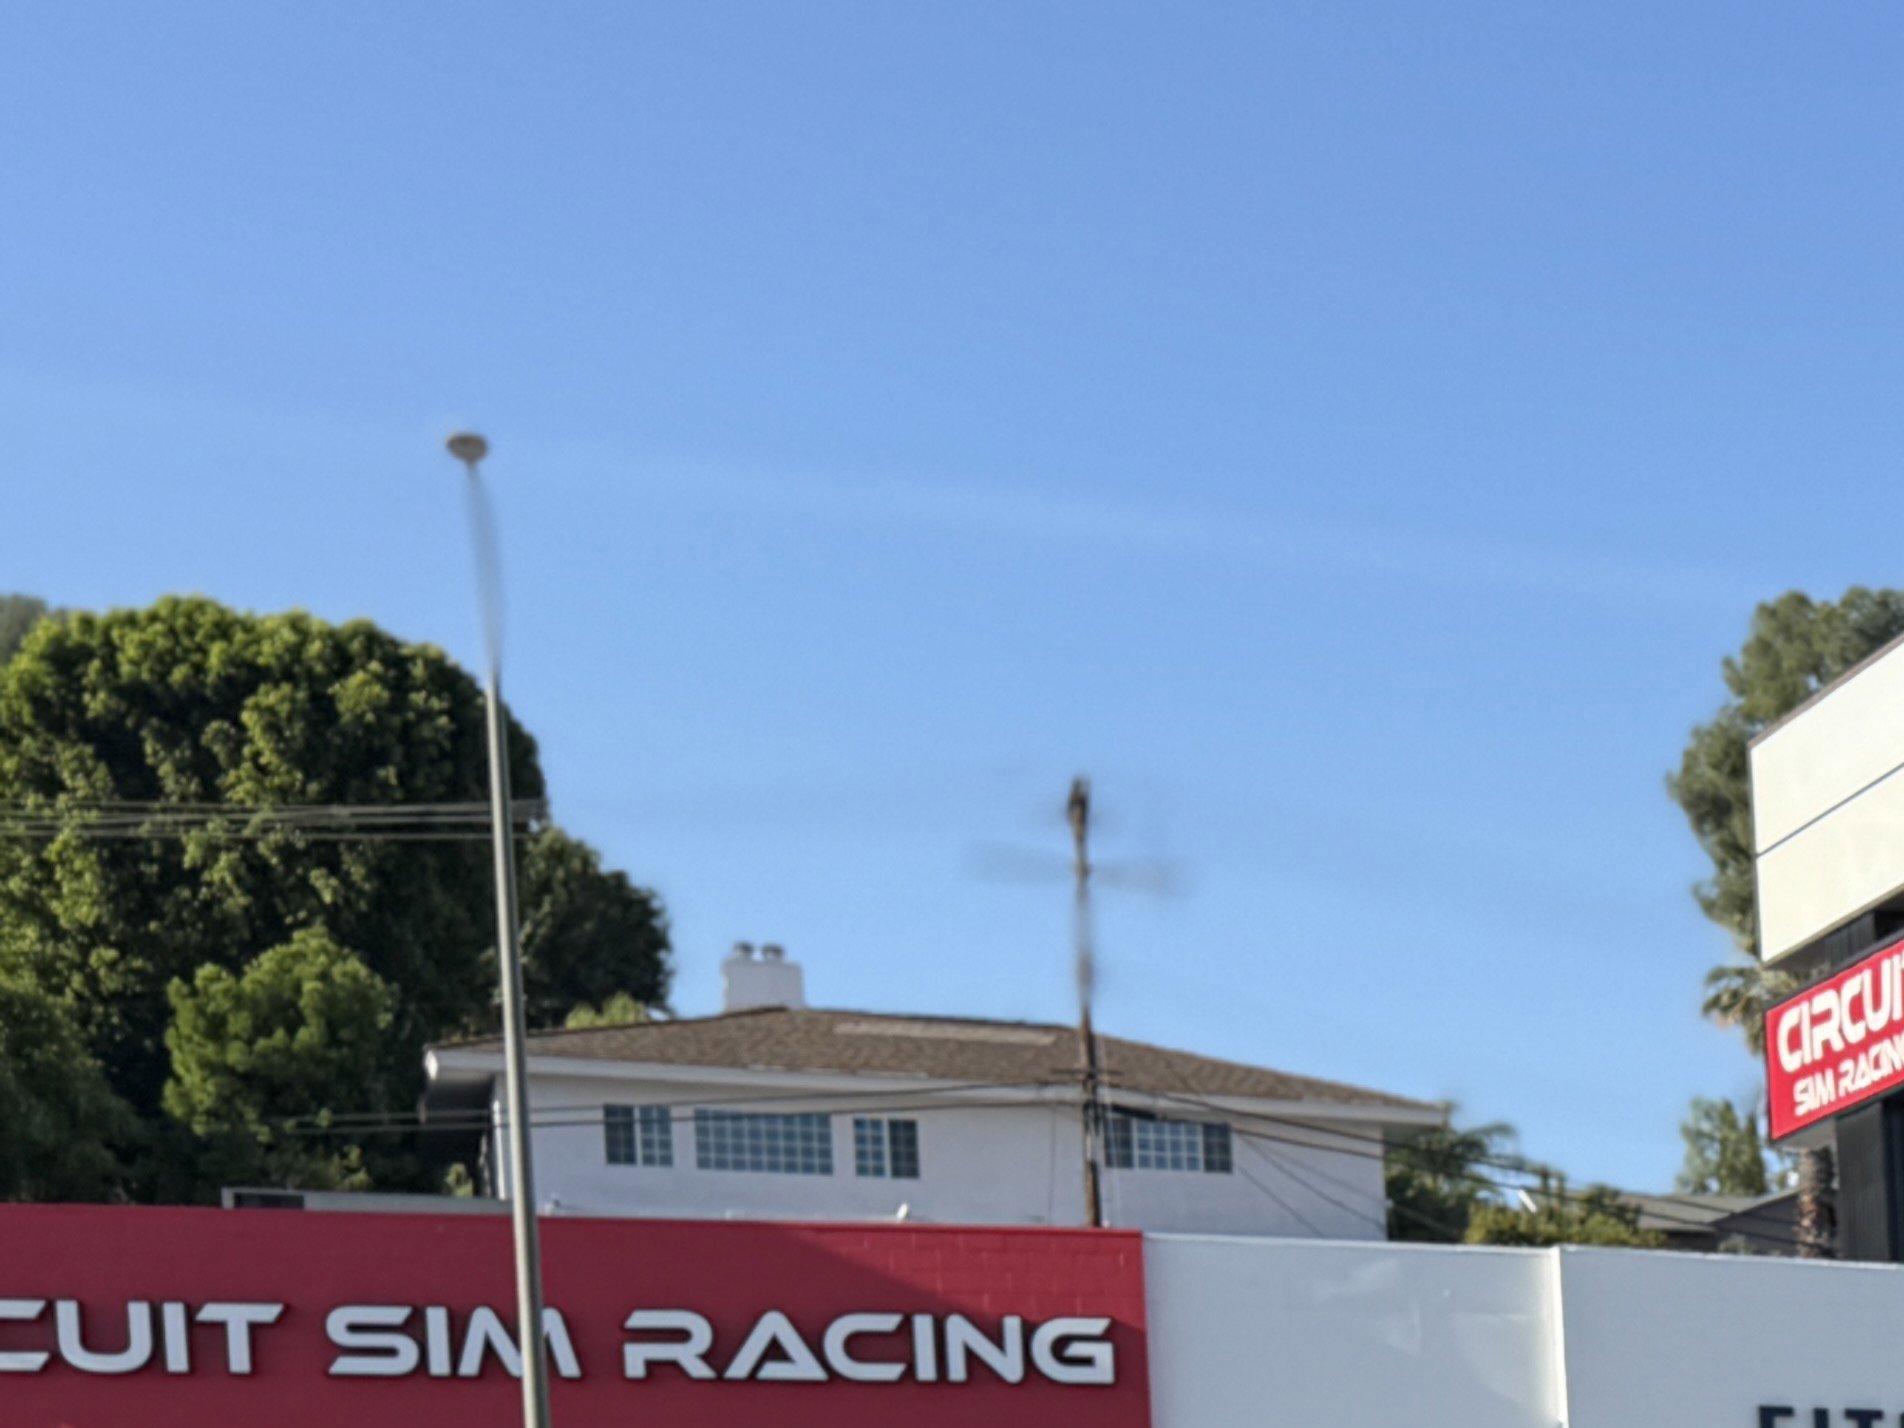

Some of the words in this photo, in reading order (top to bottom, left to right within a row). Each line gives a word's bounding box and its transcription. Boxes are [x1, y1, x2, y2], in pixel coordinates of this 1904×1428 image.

[1793, 1069, 1836, 1117] SIM
[325, 1304, 582, 1379] SIM
[623, 1309, 1116, 1385] RACING
